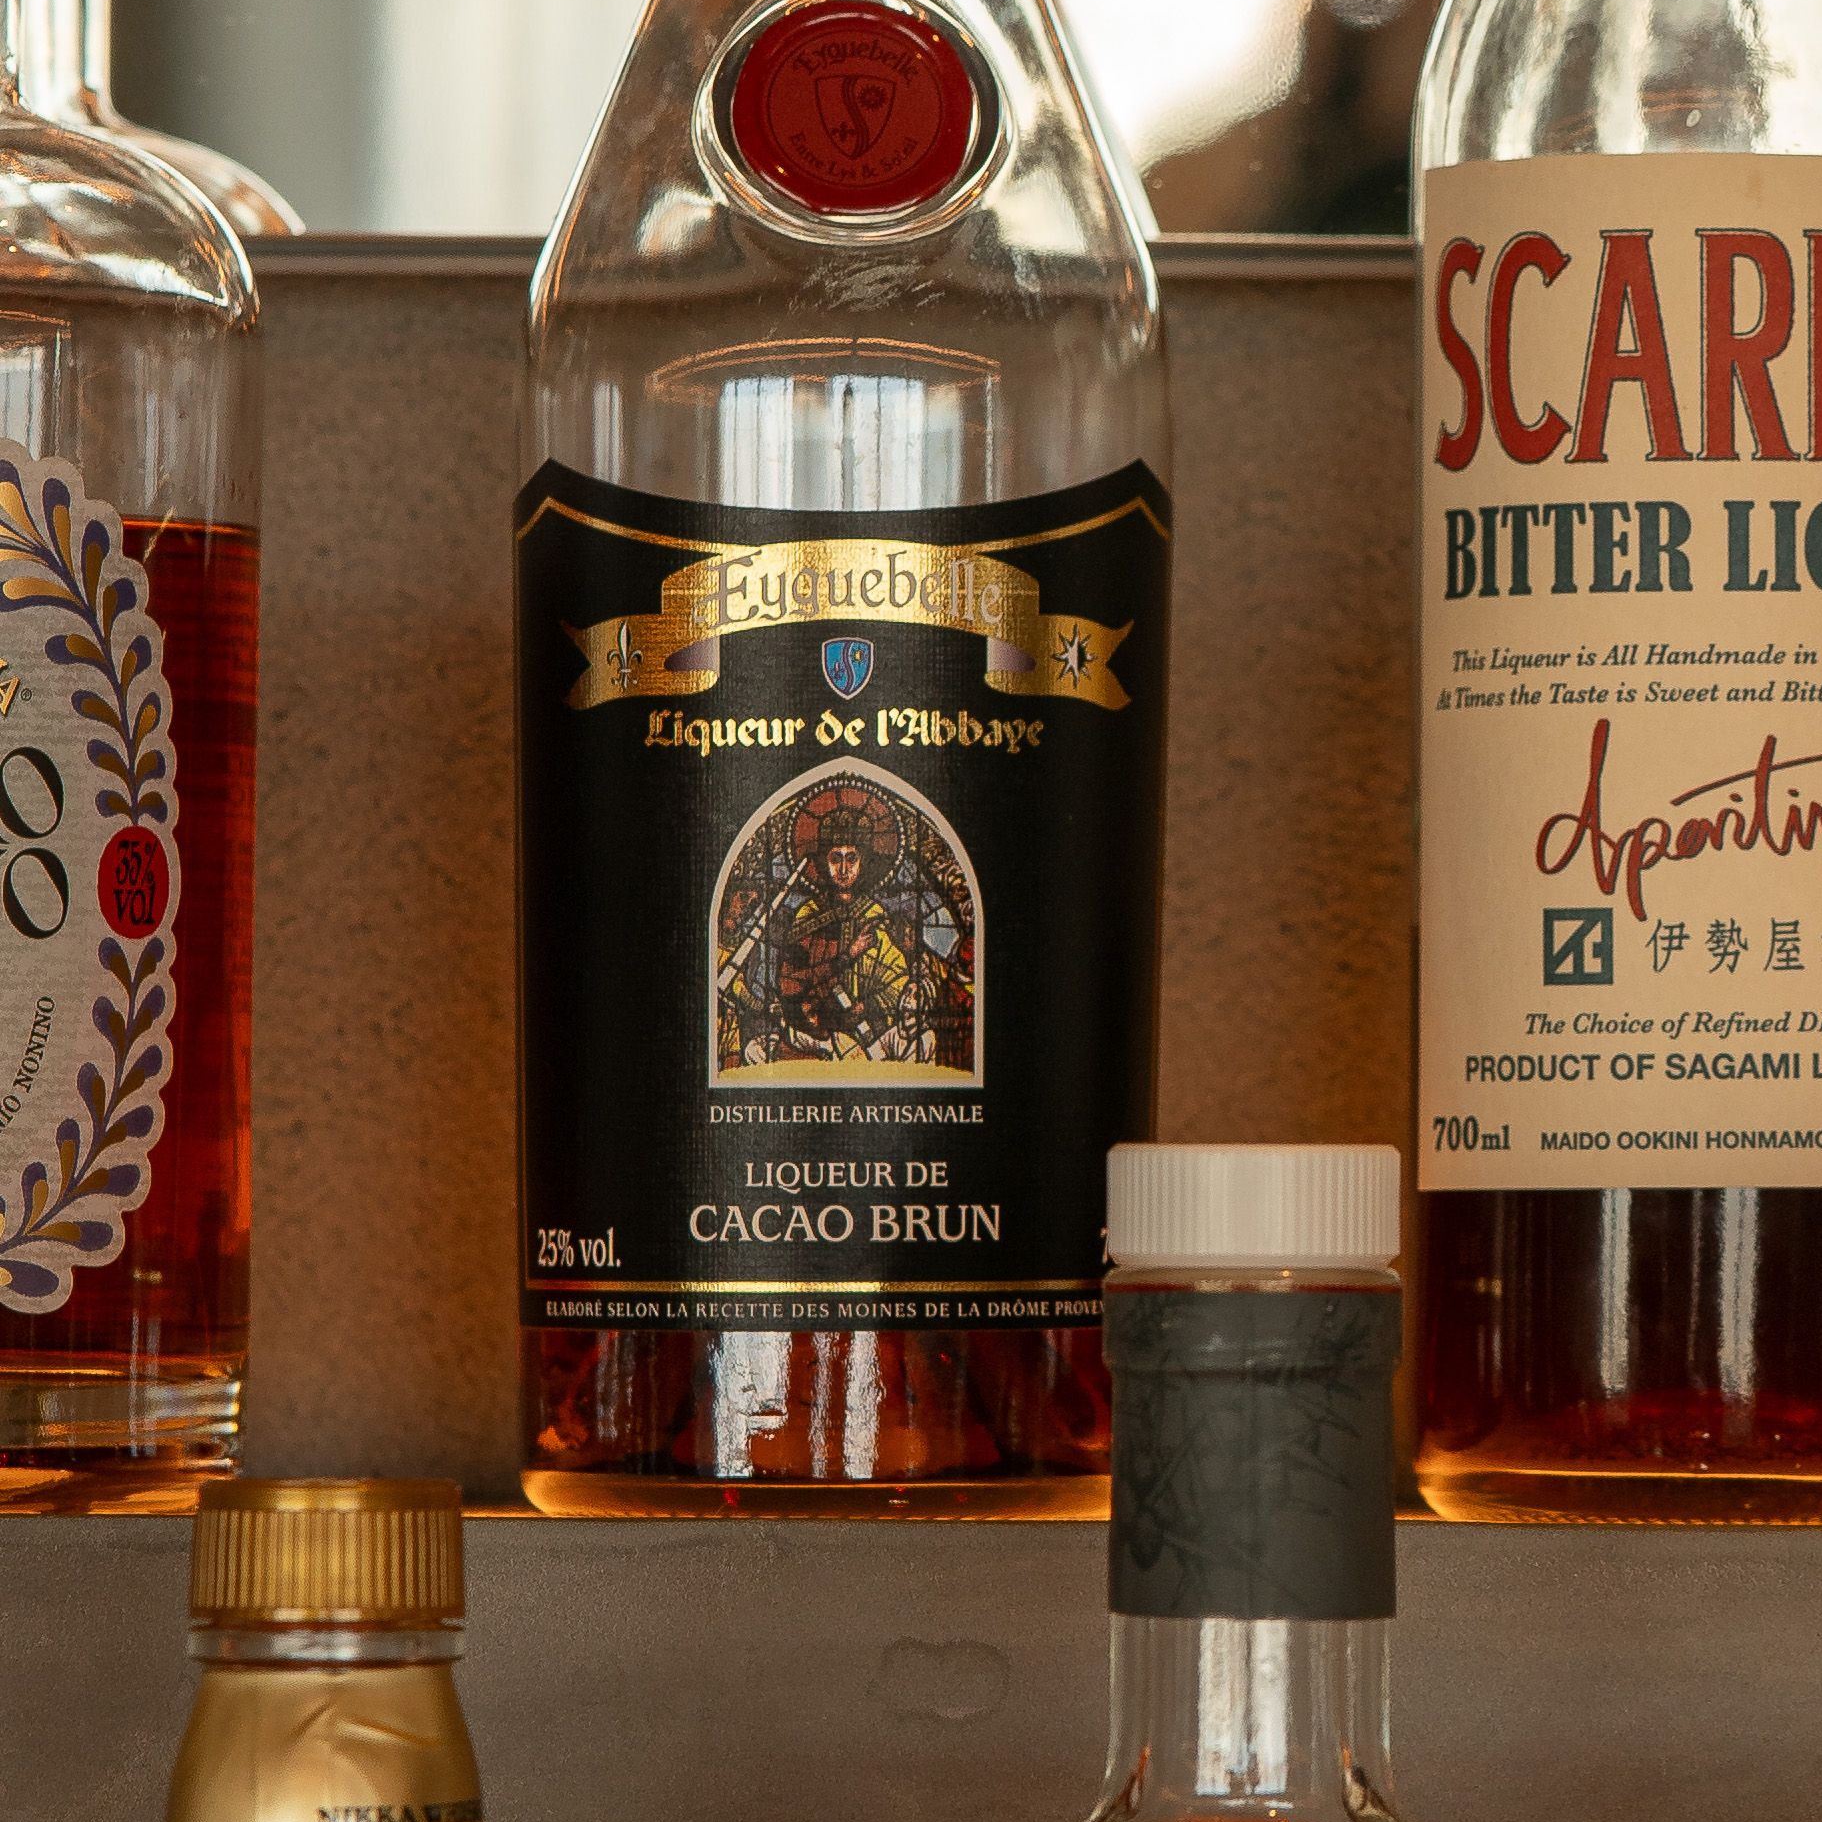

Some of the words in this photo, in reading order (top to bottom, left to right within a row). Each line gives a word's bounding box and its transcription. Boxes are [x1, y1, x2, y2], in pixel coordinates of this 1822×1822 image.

[1443, 502, 1694, 601] BITTER
[694, 549, 1003, 630] Eyguebelle
[1453, 648, 1485, 672] This
[1490, 647, 1570, 676] Liqueur
[1576, 645, 1597, 667] is
[1602, 644, 1637, 666] All
[1645, 643, 1785, 667] Handmade
[1794, 644, 1818, 666] in
[1454, 686, 1504, 709] Times
[1510, 683, 1541, 706] the
[1549, 682, 1608, 706] Taste
[1616, 681, 1636, 703] is
[1645, 680, 1719, 703] Sweet
[1726, 680, 1773, 703] and
[645, 708, 806, 758] Liqueur
[815, 709, 866, 748] de
[115, 839, 157, 886] 35%
[113, 887, 156, 925] vol
[1525, 1013, 1567, 1035] The
[1572, 1012, 1654, 1035] Choice
[1661, 1012, 1691, 1039] of
[1693, 1011, 1791, 1039] Refined
[13, 995, 55, 1094] NONINO
[1466, 1054, 1600, 1082] PRODUCT
[1610, 1053, 1655, 1080] OF
[1664, 1053, 1799, 1080] SAGAMI
[709, 1104, 843, 1124] DISTILLERIE
[849, 1104, 984, 1124] ARTISANALE
[1433, 1115, 1510, 1152] 700ml
[1541, 1131, 1609, 1150] MAIDO
[1617, 1131, 1698, 1150] OOKINI
[746, 1161, 895, 1193] LIQUEUR
[905, 1161, 948, 1188] DE
[689, 1203, 854, 1243] CACAO
[870, 1204, 1001, 1242] BRUN
[537, 1228, 574, 1267] 25%
[580, 1227, 621, 1268] vol.
[607, 1301, 660, 1319] SELON
[666, 1301, 689, 1319] LA
[696, 1301, 785, 1319] RECETTE
[792, 1301, 830, 1319] DES
[838, 1301, 918, 1319] MOINES
[925, 1301, 950, 1318] DE
[957, 1300, 981, 1318] LA
[988, 1298, 1050, 1317] DRÔME
